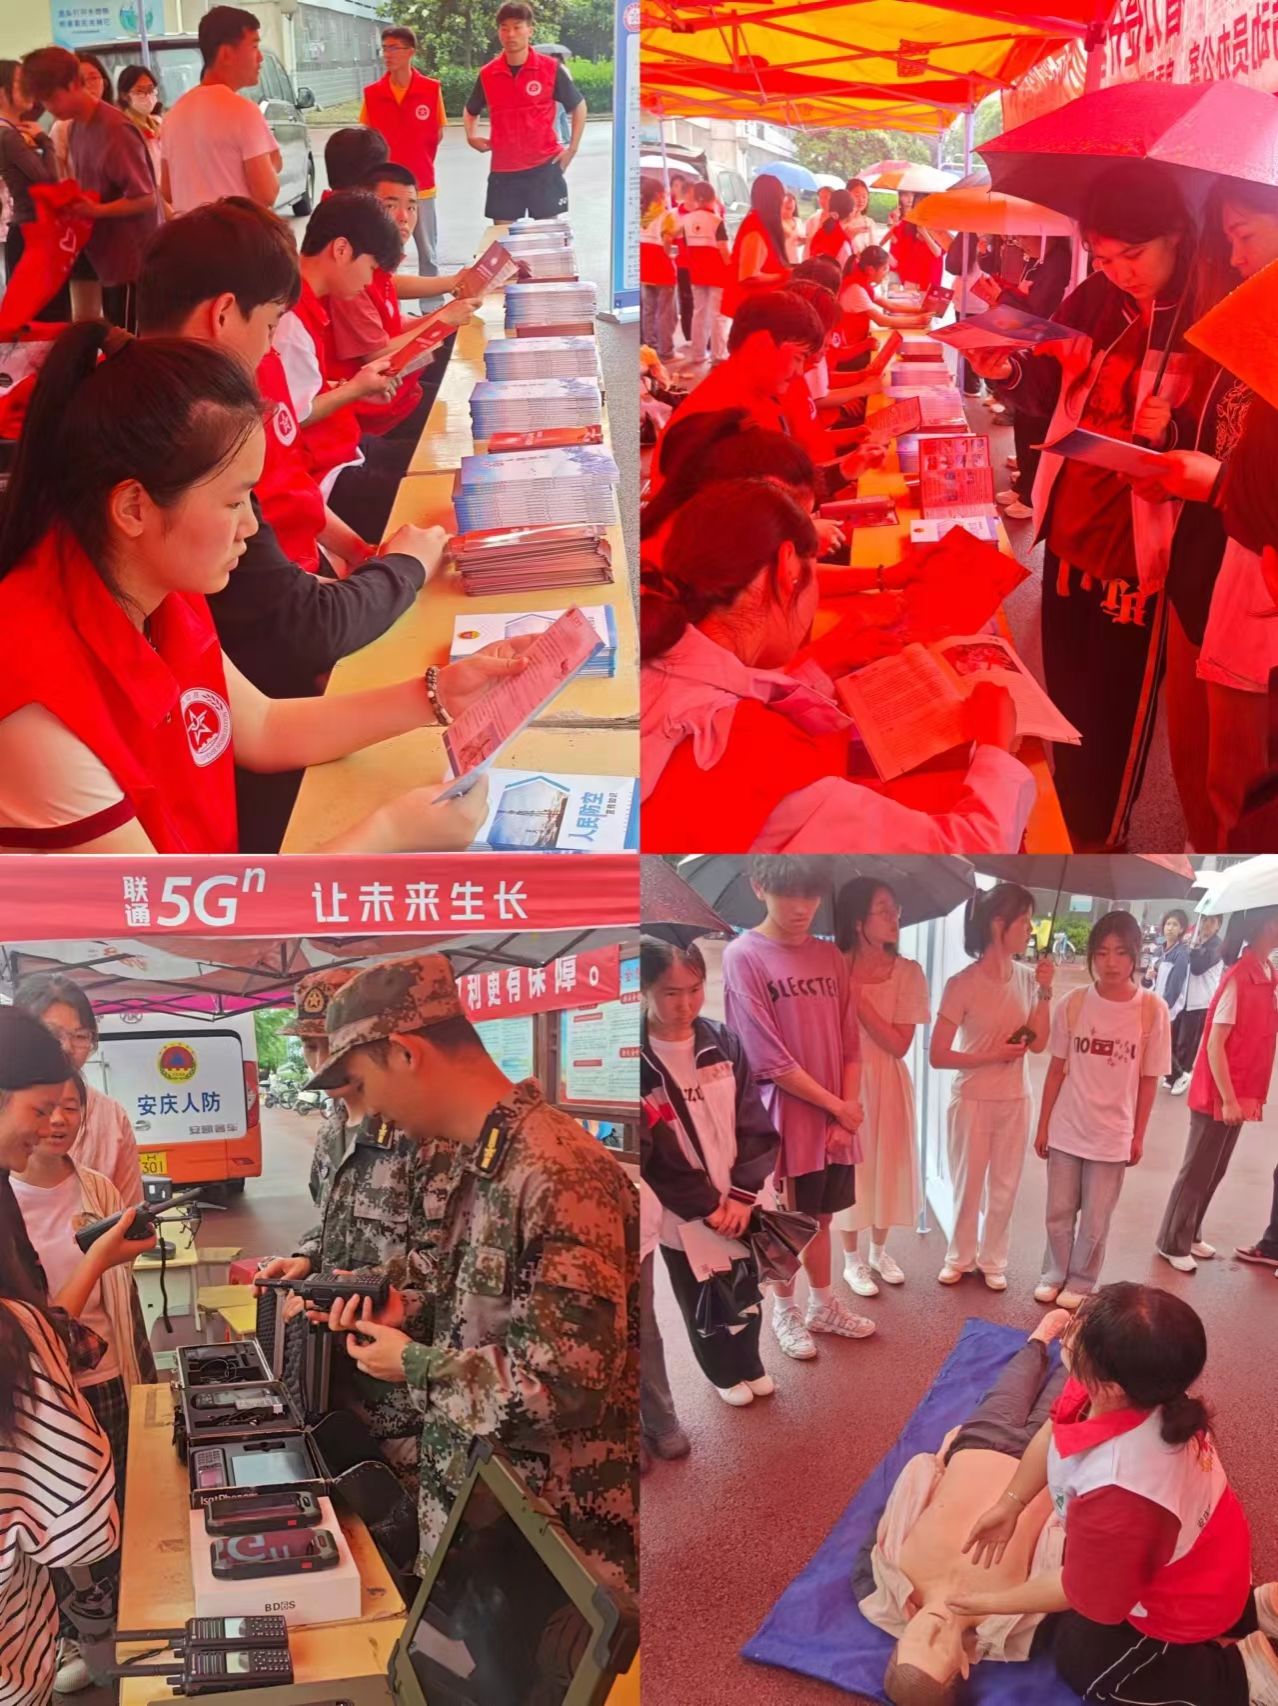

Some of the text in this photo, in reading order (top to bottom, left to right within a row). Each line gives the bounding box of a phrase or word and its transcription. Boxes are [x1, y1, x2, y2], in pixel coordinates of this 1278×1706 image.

[568, 792, 606, 842] 人民防空
[123, 876, 150, 927] 联通
[312, 881, 528, 922] 让未来生长
[455, 955, 599, 1011] 利更有保障。
[137, 1091, 221, 1116] 安庆人防
